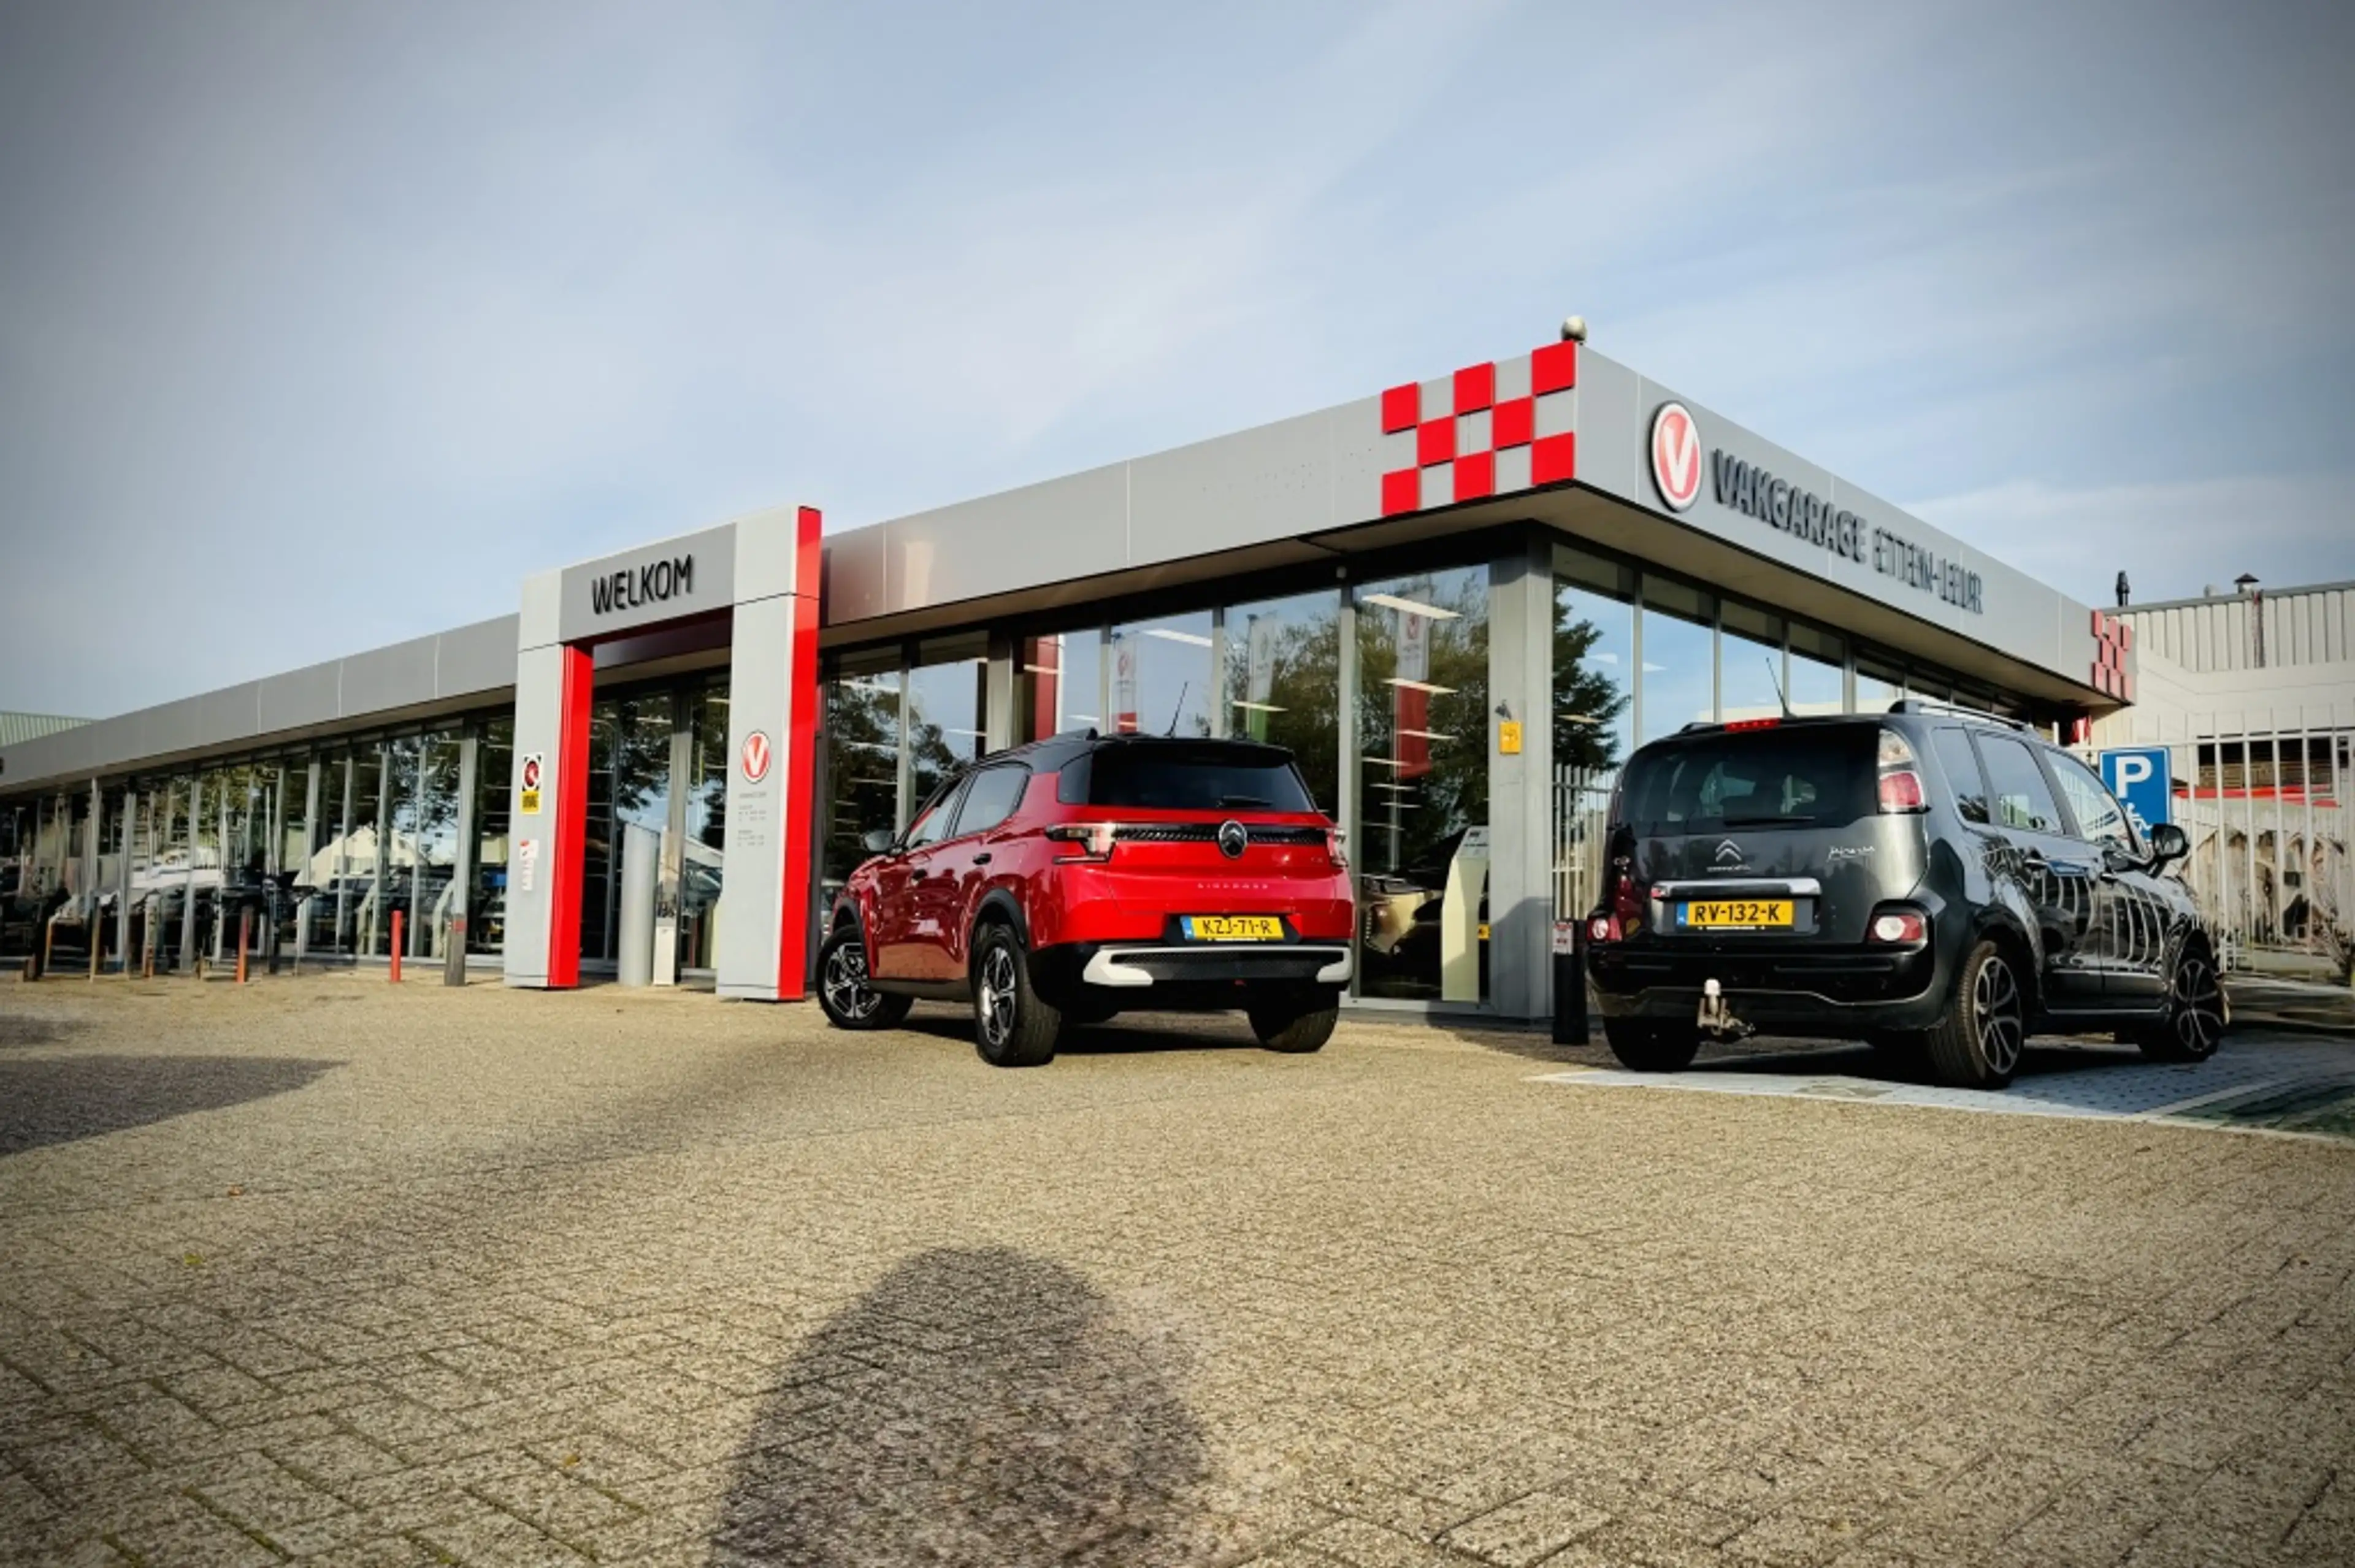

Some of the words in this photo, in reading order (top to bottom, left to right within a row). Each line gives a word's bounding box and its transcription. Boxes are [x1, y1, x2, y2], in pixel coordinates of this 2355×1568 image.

[1711, 448, 1867, 564] VAKGARAGE
[1872, 527, 1983, 614] ETTEN-LEUR
[592, 554, 694, 614] WELKOM
[2115, 755, 2153, 798] P
[1694, 903, 1781, 922] RV-132-K
